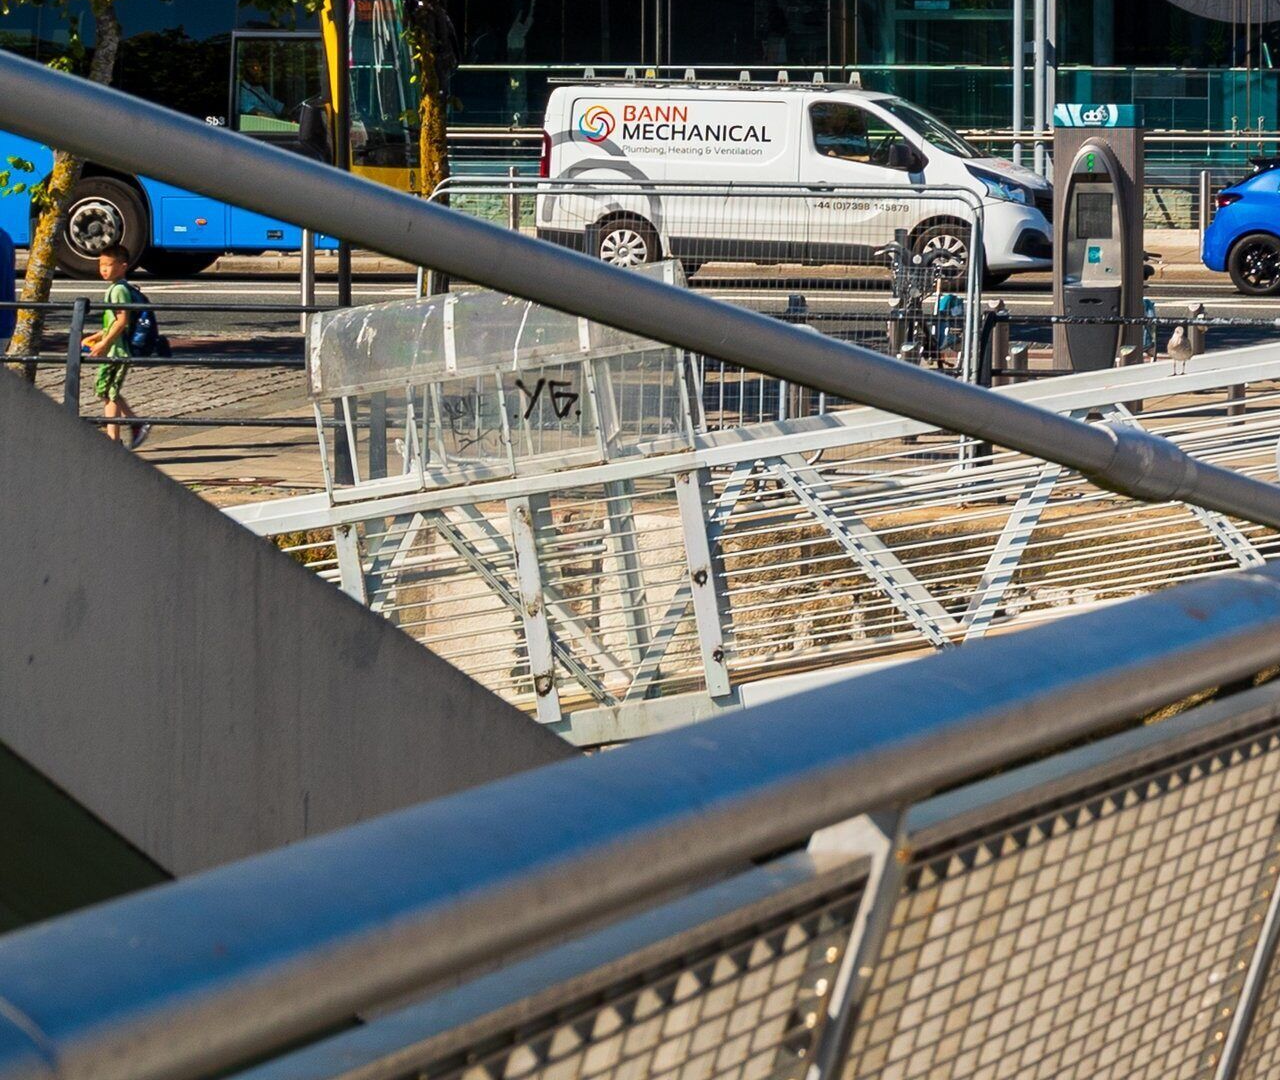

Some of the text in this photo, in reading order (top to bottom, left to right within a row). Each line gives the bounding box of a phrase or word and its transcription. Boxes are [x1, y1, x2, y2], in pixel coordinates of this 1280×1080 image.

[623, 105, 688, 122] BANN
[622, 123, 771, 143] MECHANICAL
[621, 145, 763, 157] Plumbing, Heating & Ventilation
